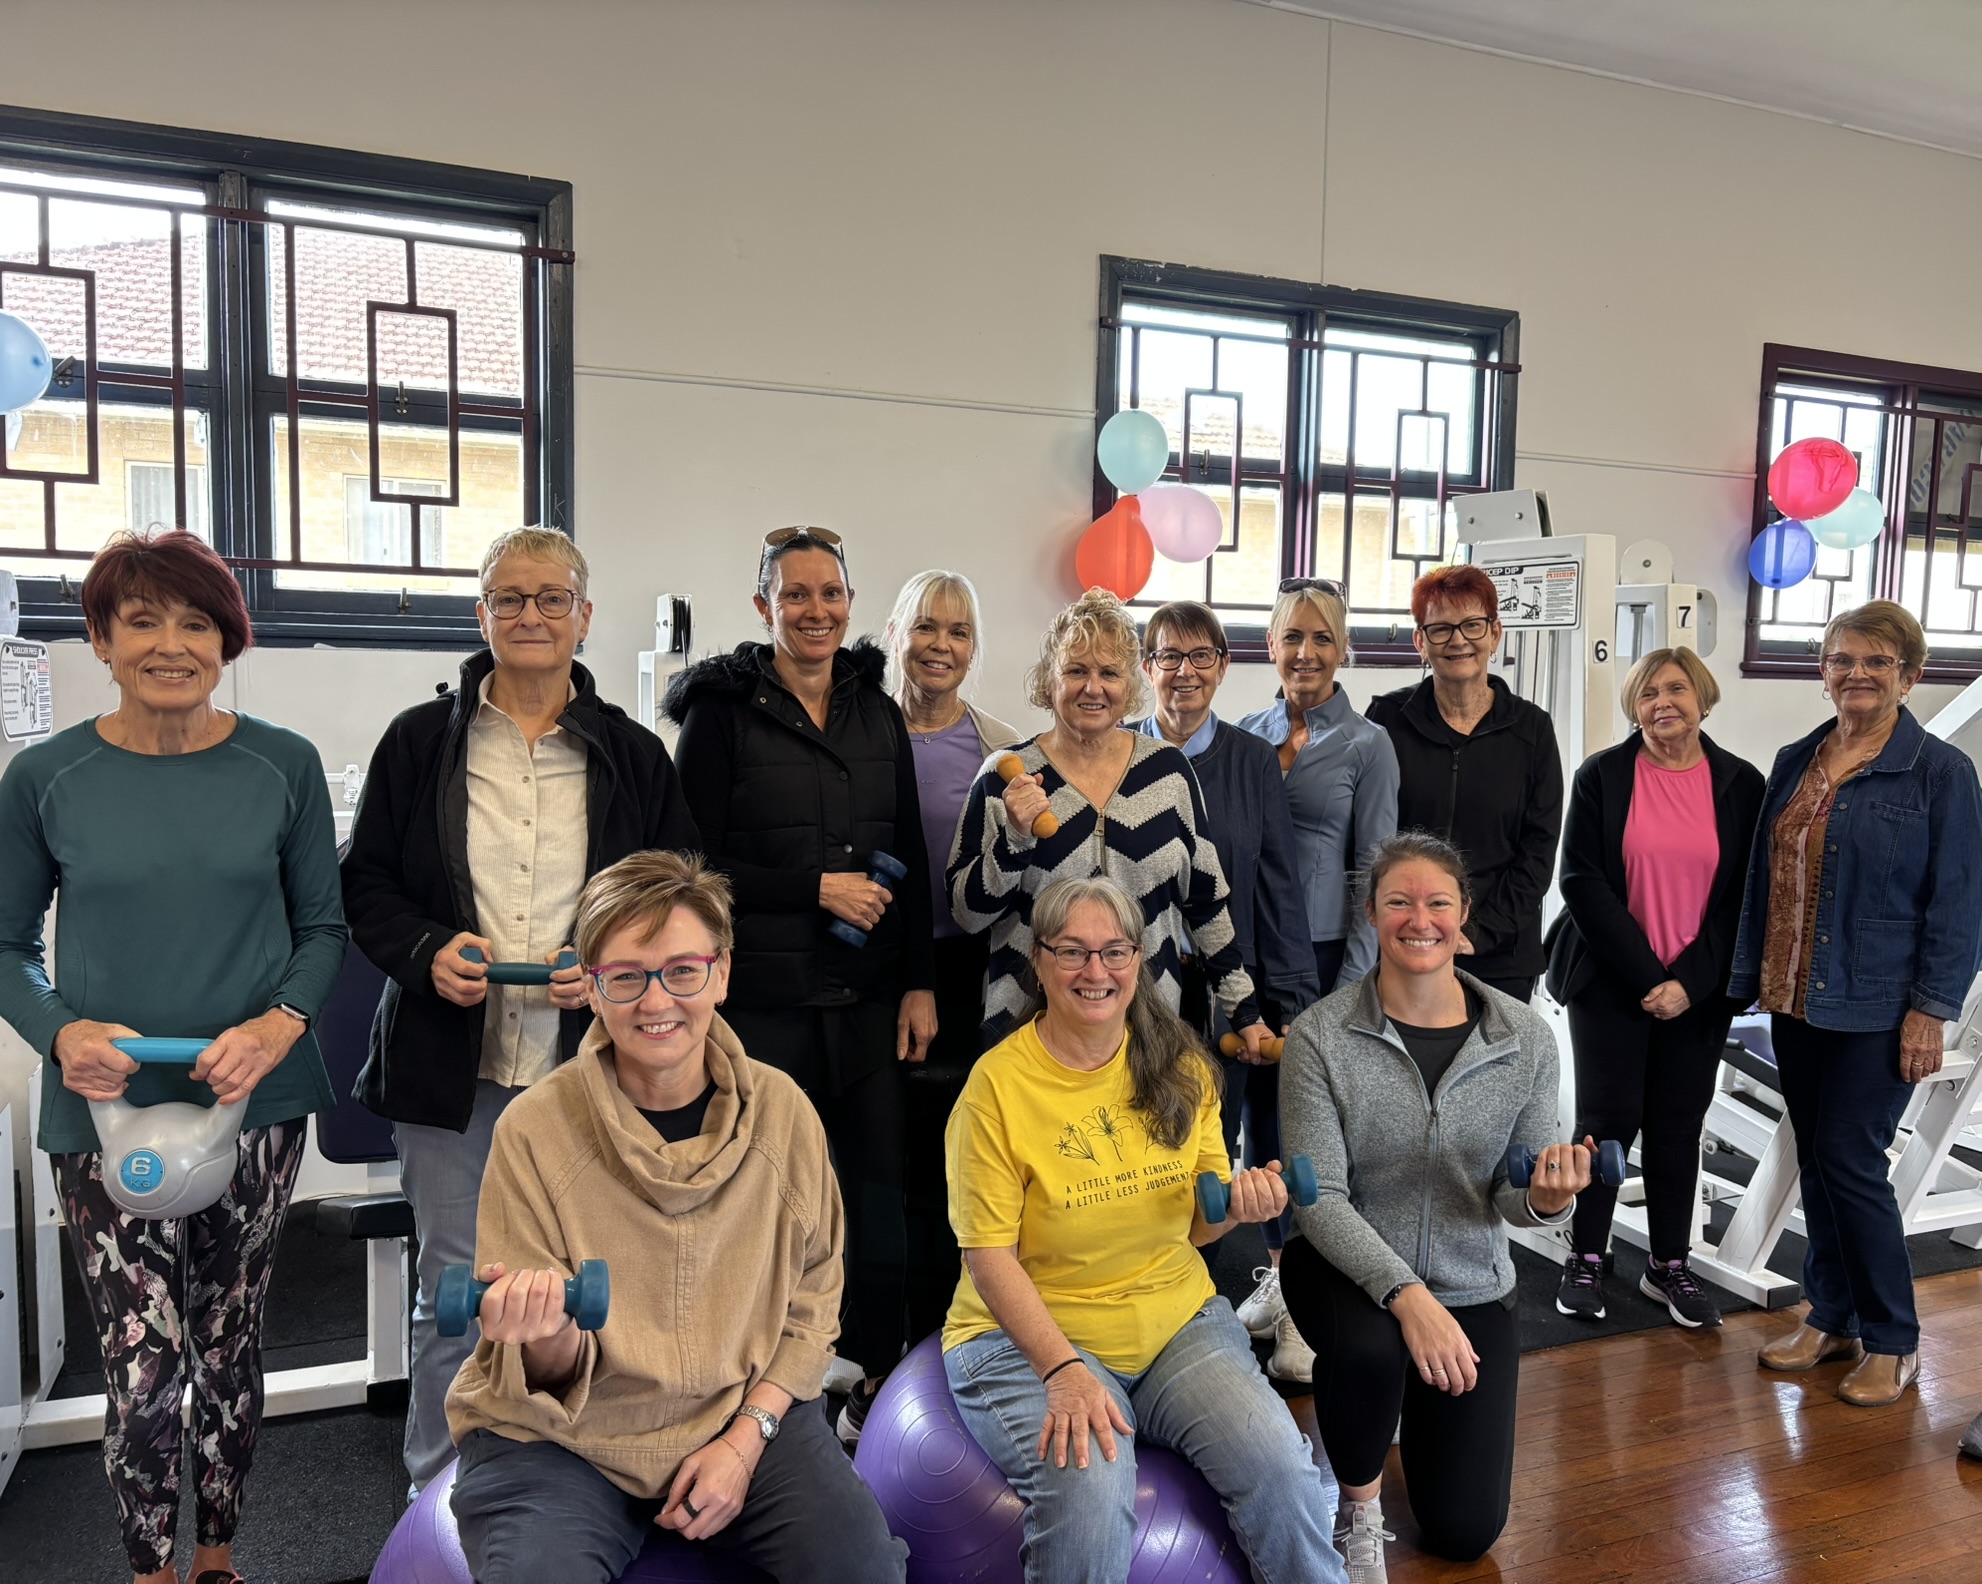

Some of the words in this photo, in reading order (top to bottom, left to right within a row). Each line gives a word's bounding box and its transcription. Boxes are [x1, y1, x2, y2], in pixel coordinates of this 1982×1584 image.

[1504, 567, 1519, 575] DIP
[1678, 605, 1691, 627] 7
[1594, 639, 1608, 662] 6
[131, 1156, 151, 1175] 6
[131, 1178, 151, 1188] KG
[1066, 1185, 1072, 1194] A
[1076, 1176, 1111, 1192] LITTLE
[1115, 1169, 1138, 1183] MORE
[1143, 1160, 1183, 1176] KINDNESS
[1065, 1200, 1071, 1209] A
[1076, 1191, 1111, 1207] LITTLE
[1116, 1184, 1139, 1198] LESS
[1145, 1172, 1190, 1191] JUDGEMENT
